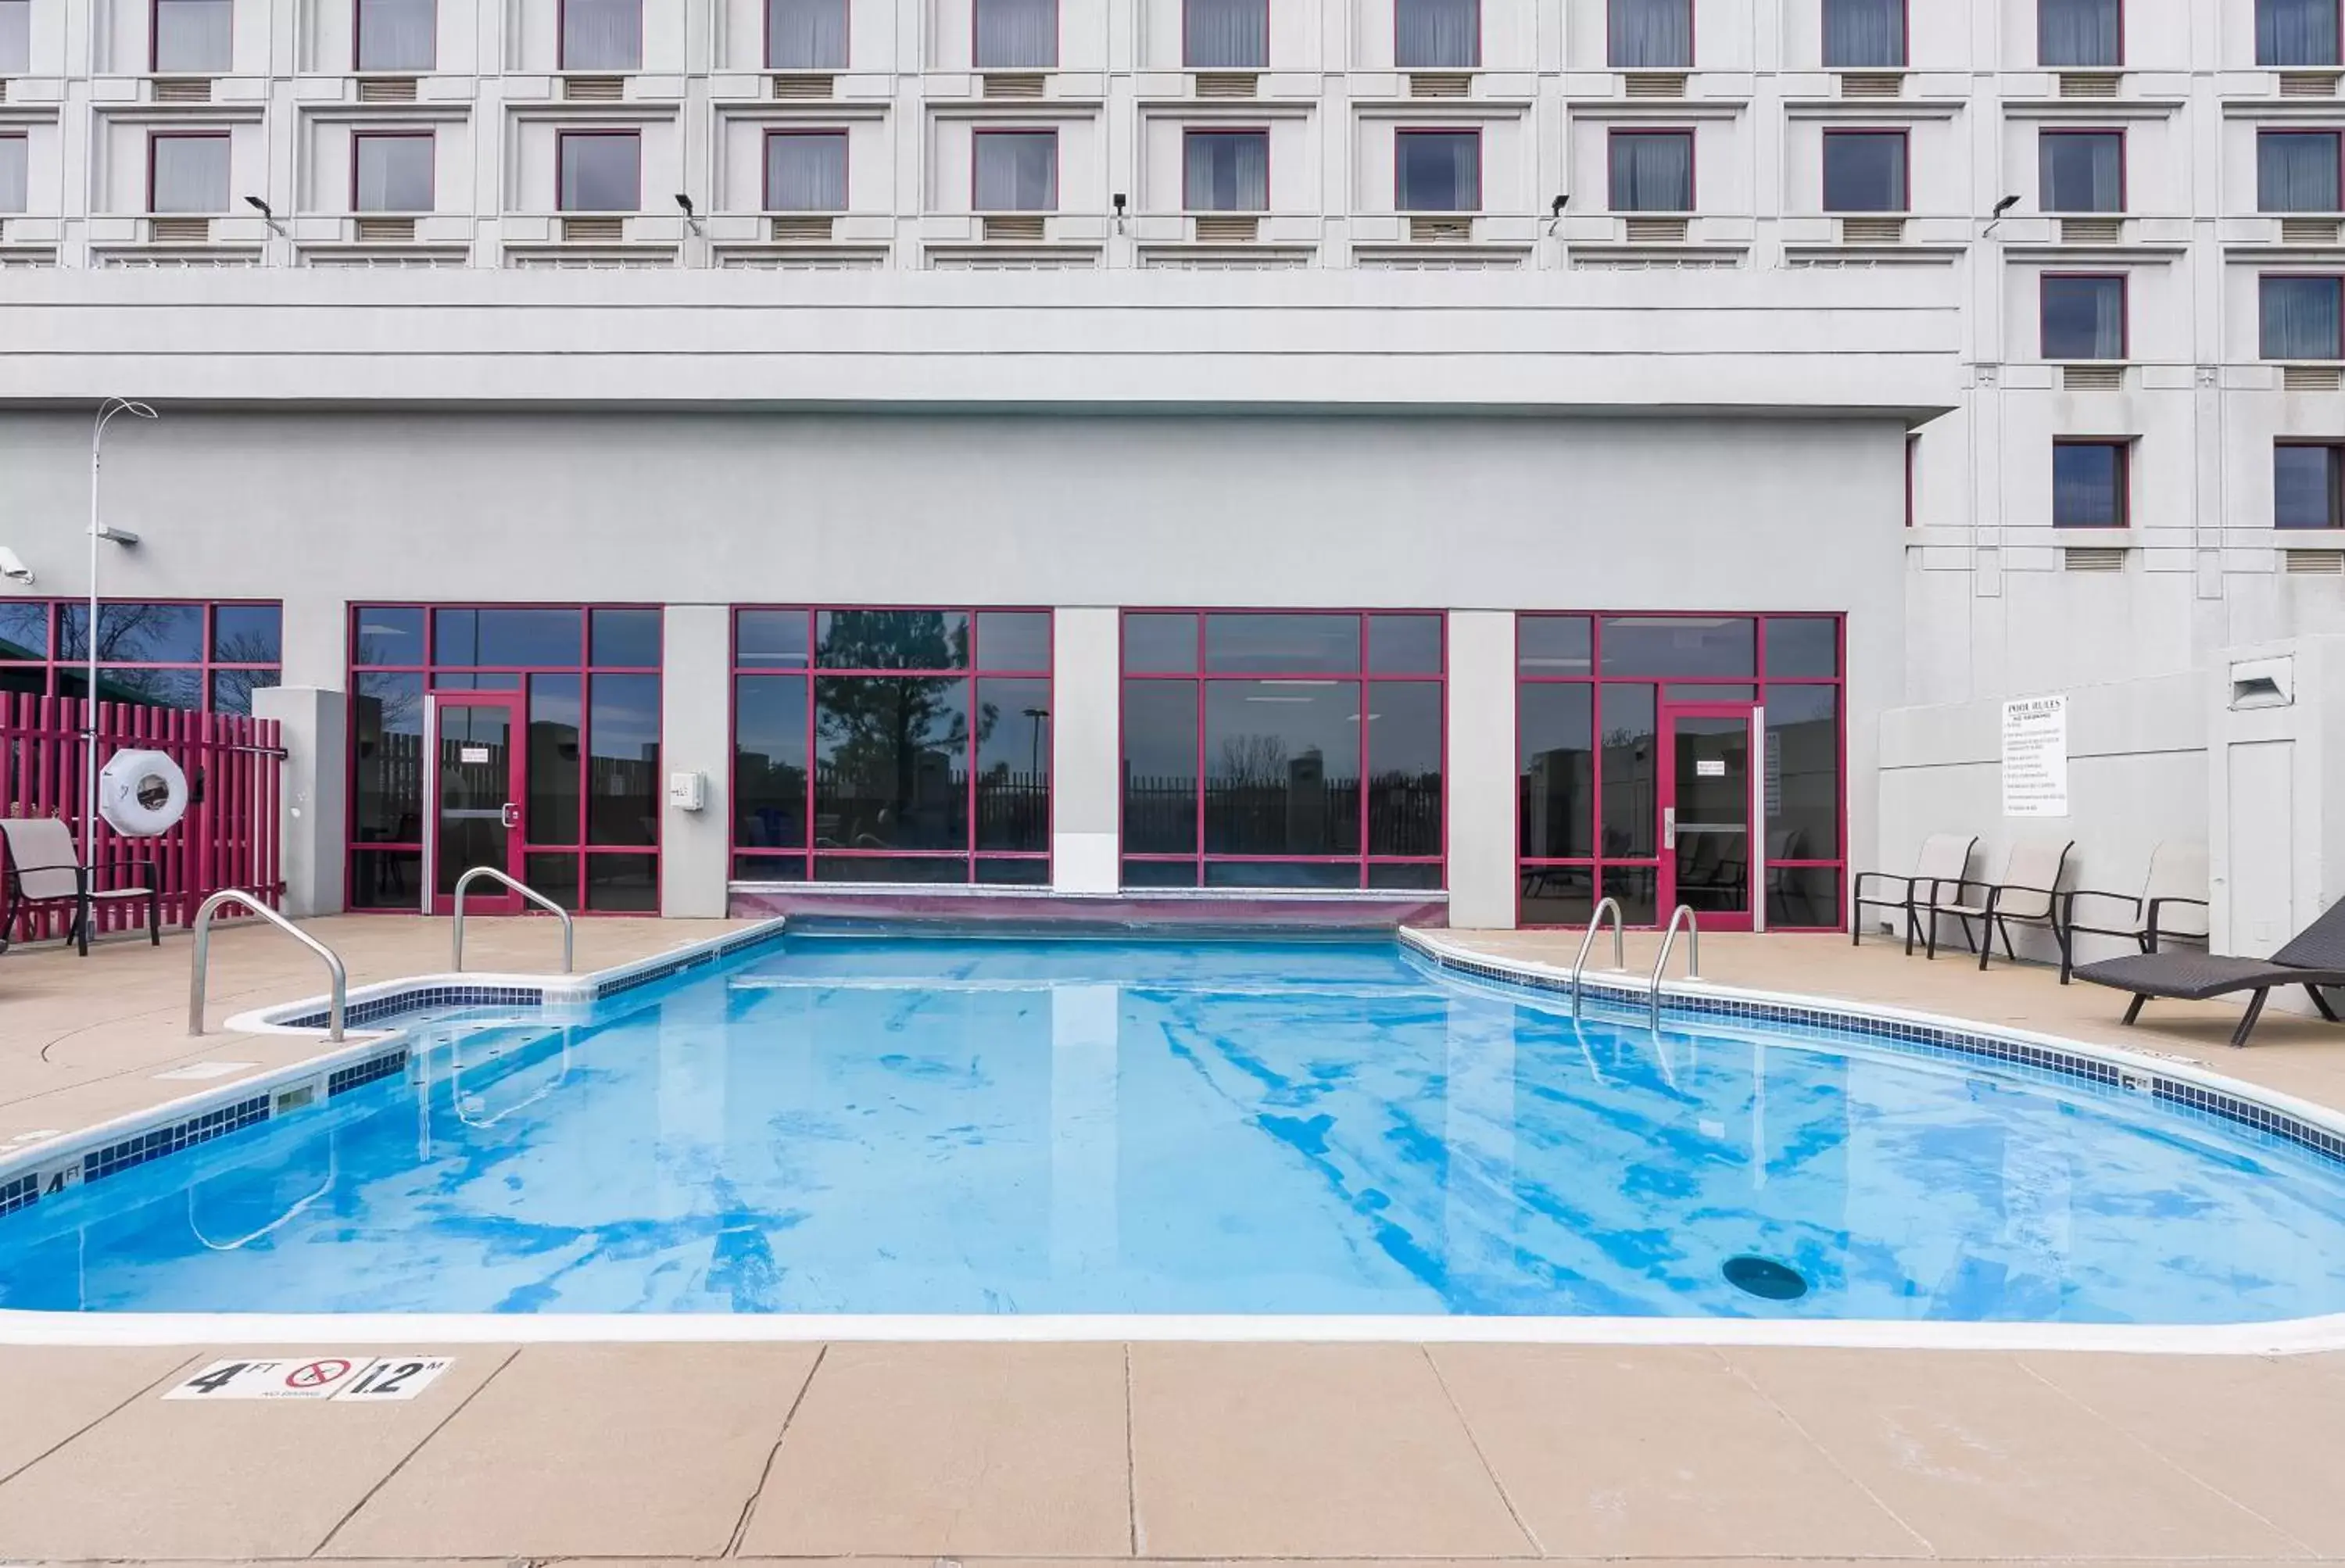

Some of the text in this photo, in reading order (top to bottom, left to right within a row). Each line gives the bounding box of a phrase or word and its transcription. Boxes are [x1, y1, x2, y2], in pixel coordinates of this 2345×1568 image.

[2122, 1075, 2136, 1090] 5
[66, 1165, 79, 1181] FT
[185, 1362, 250, 1393] 4
[247, 1362, 282, 1373] FT
[426, 1362, 444, 1370] M
